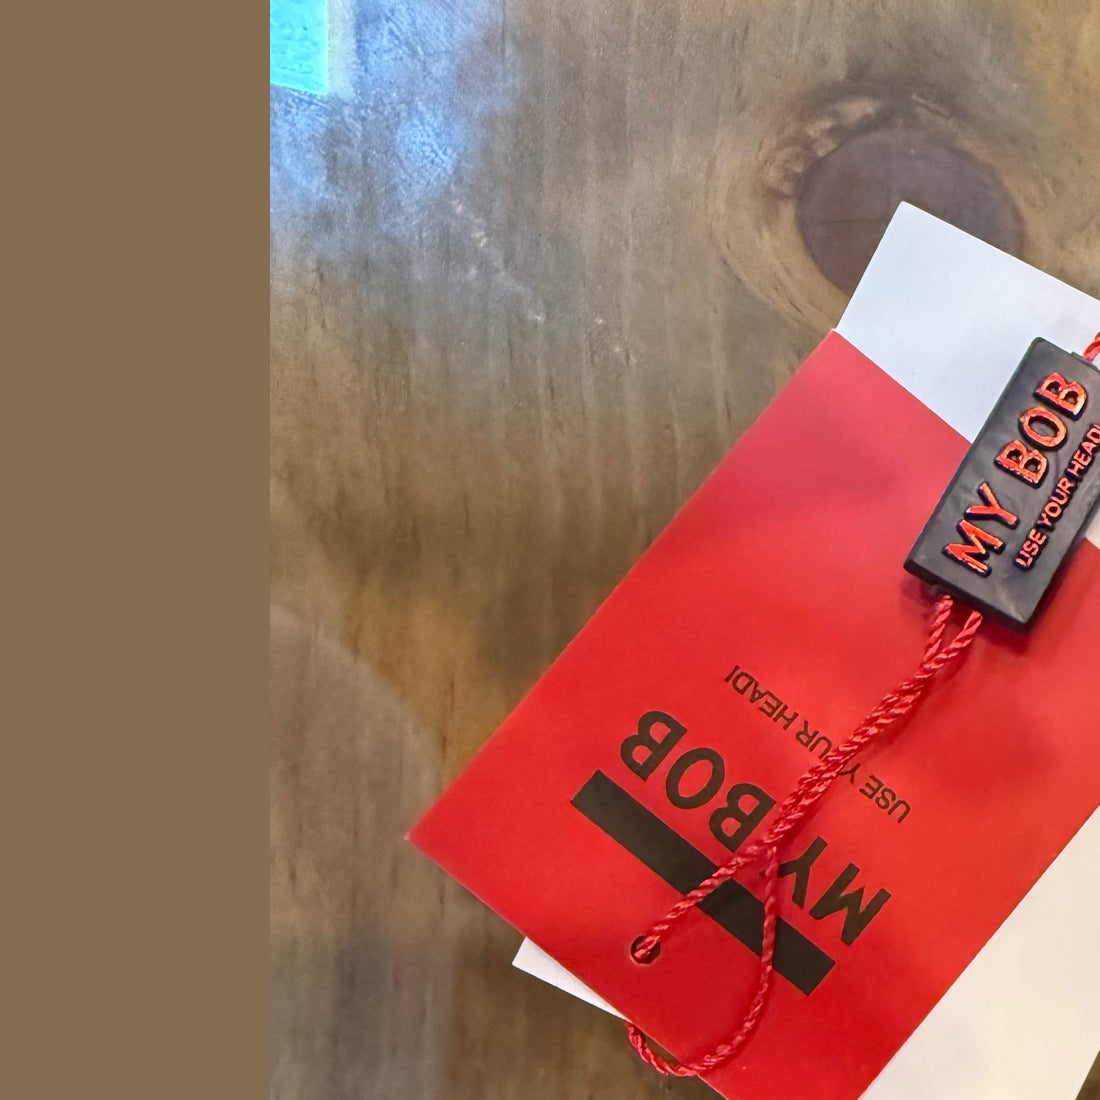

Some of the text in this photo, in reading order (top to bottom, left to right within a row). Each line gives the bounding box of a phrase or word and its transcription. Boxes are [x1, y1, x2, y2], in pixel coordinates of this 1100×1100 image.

[942, 371, 1088, 577] MY BOB
[1013, 527, 1047, 570] USE
[1038, 476, 1075, 530] YOUR
[796, 719, 861, 784] YUR
[859, 774, 911, 823] USE
[620, 710, 892, 946] MY BOB
